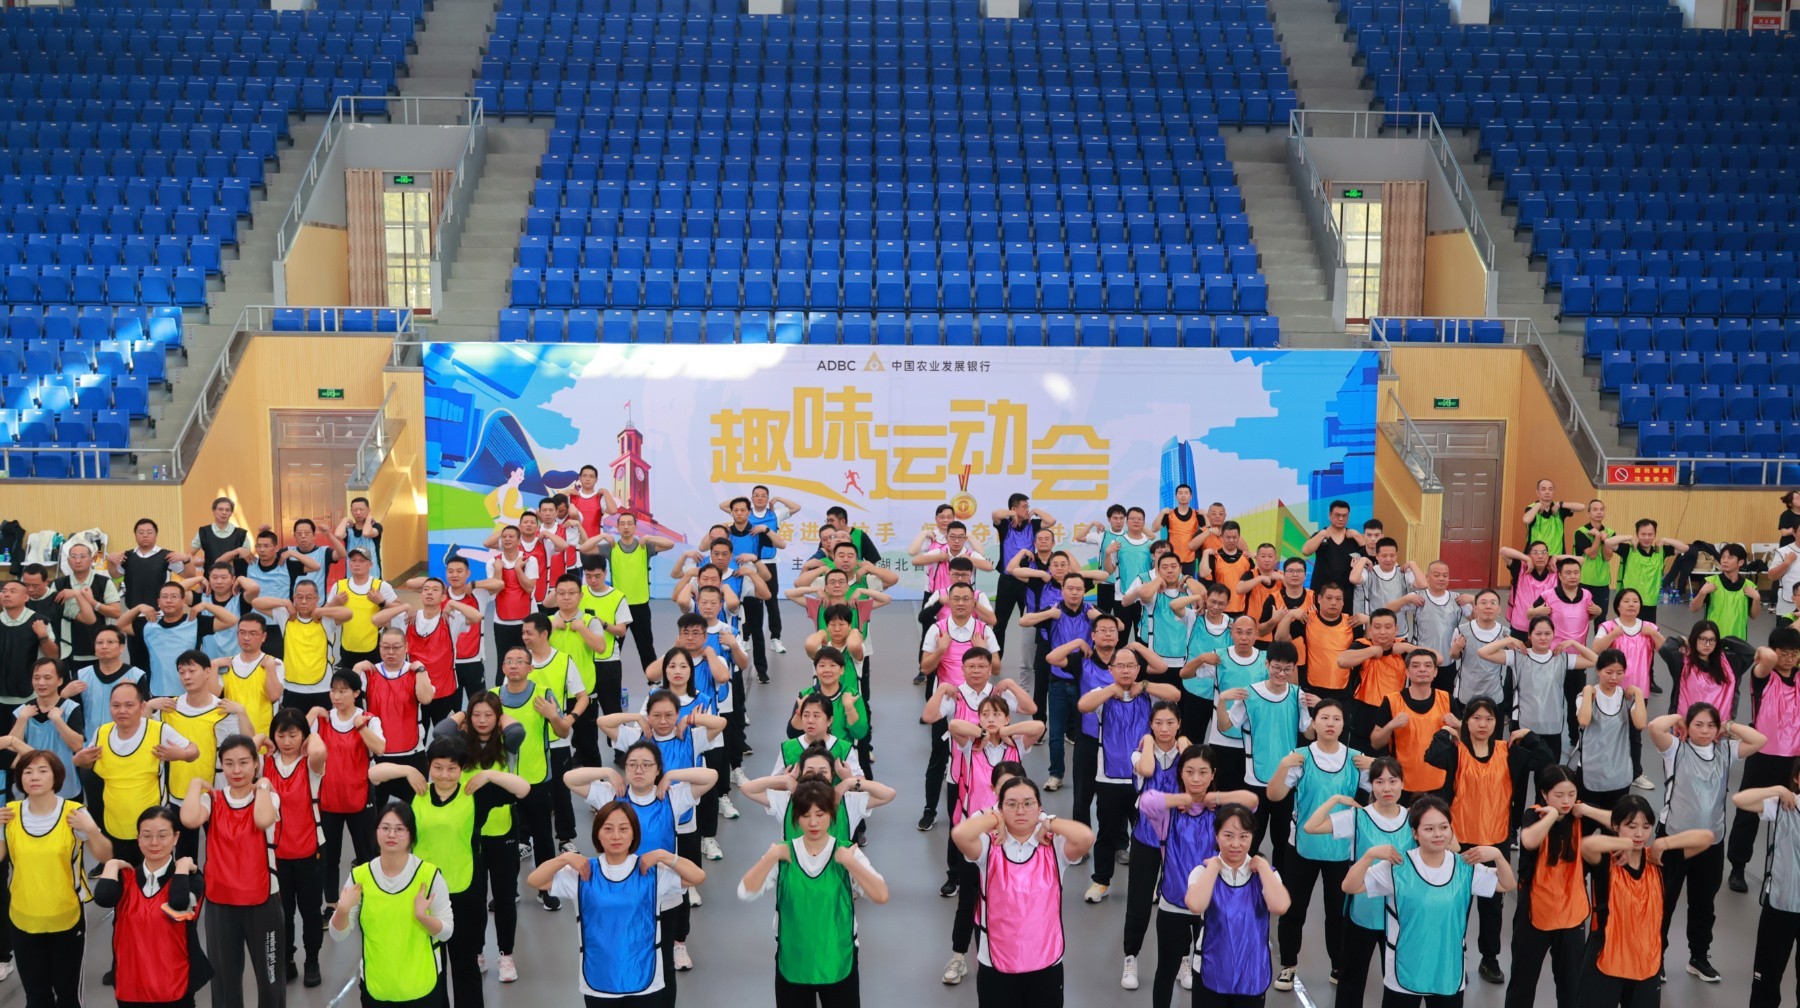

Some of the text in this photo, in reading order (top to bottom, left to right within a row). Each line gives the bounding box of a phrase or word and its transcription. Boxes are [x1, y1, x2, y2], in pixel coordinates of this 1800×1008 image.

[816, 360, 856, 371] ADBC
[891, 360, 991, 372] 中国农业发展银行
[710, 385, 1110, 504] 趣味运动会
